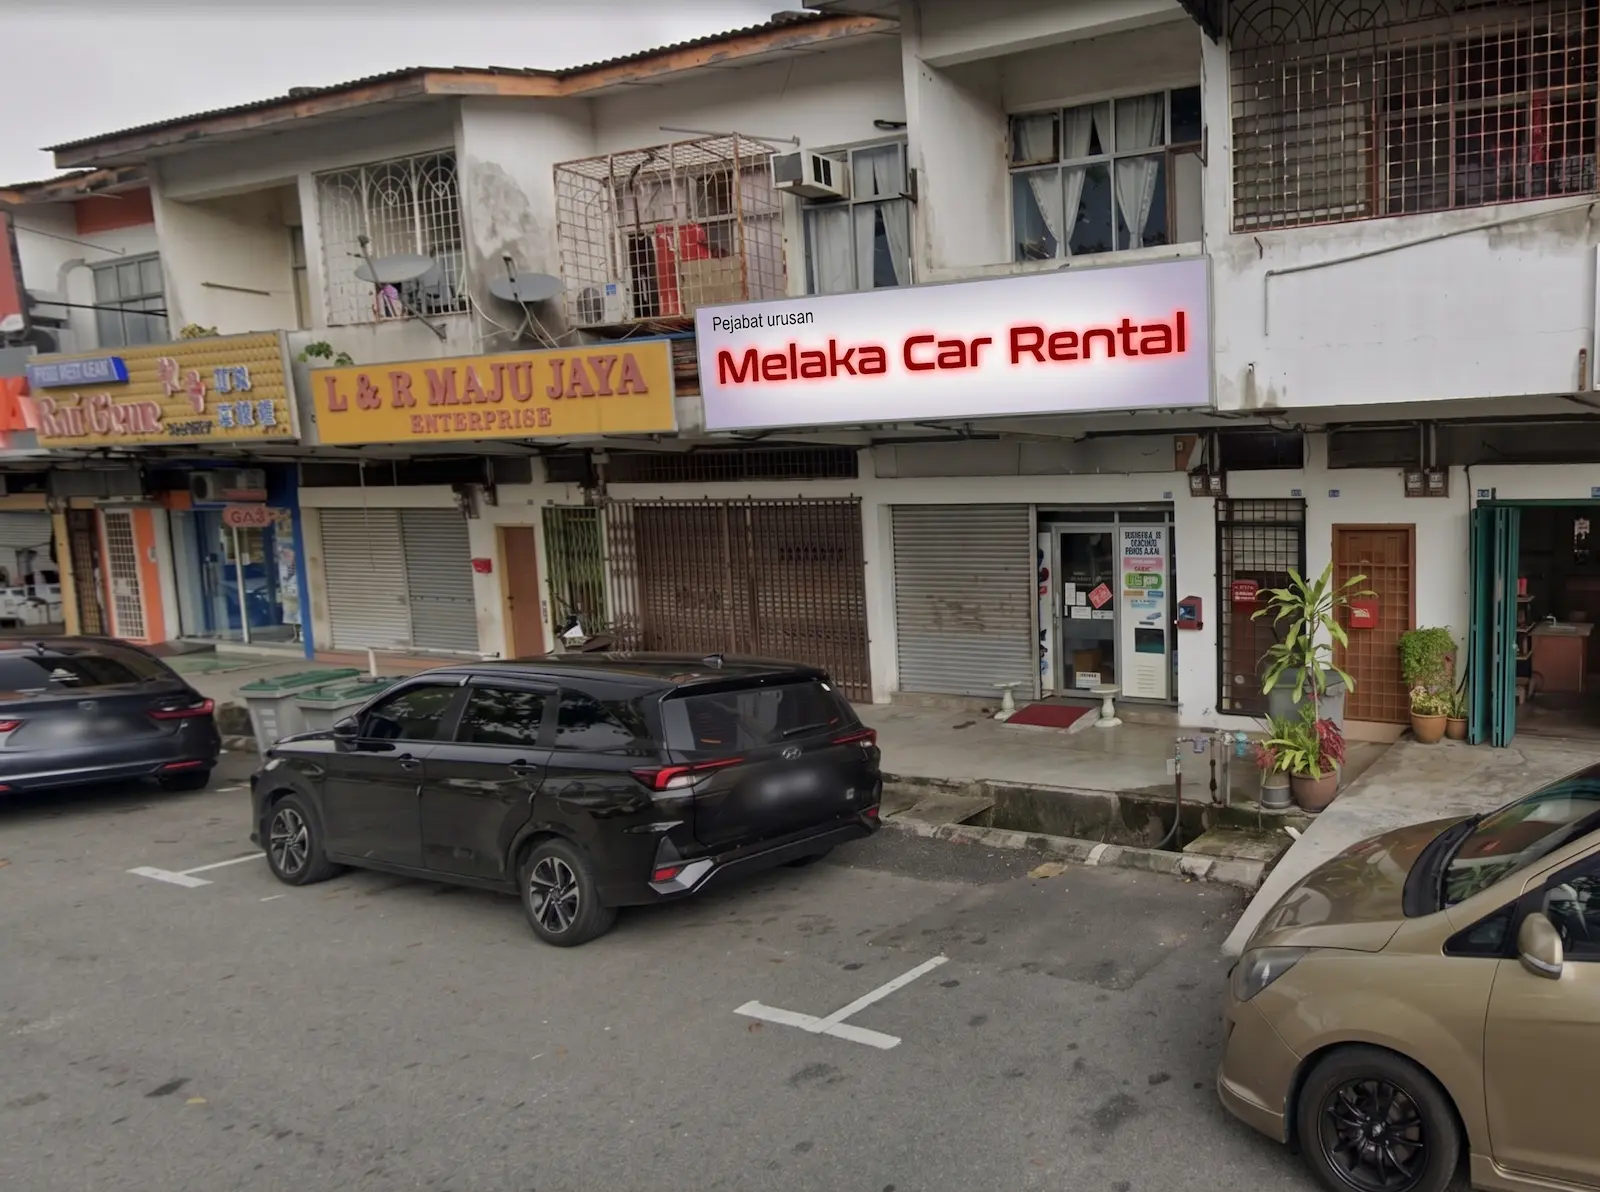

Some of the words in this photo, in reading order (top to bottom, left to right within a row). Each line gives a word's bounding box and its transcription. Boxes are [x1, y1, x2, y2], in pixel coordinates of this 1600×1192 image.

[712, 313, 763, 334] Pejabat
[767, 310, 815, 328] urusan
[717, 339, 887, 385] Melaka
[903, 334, 992, 371] Car
[1009, 311, 1186, 364] Rental
[325, 376, 348, 411] L
[356, 374, 382, 409] &
[388, 370, 417, 408] R
[425, 361, 534, 406] MAJU
[546, 353, 649, 400] JAYA
[410, 407, 553, 434] ENTERPRISE
